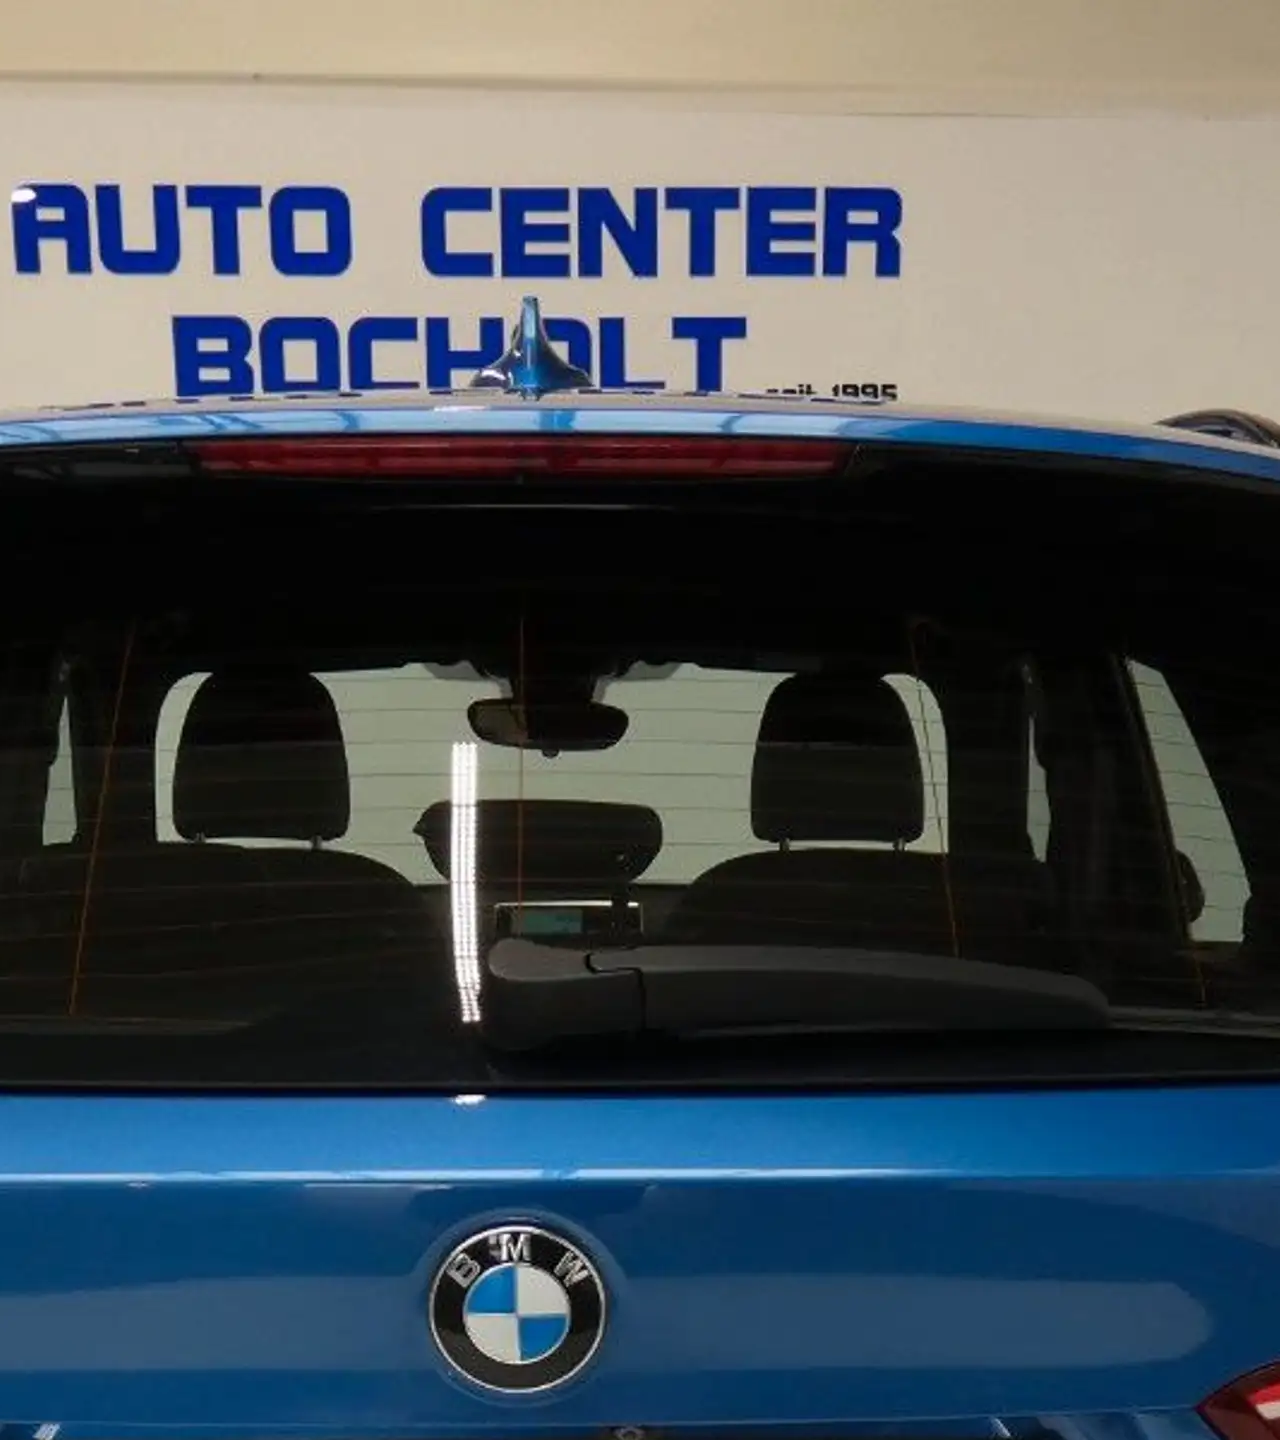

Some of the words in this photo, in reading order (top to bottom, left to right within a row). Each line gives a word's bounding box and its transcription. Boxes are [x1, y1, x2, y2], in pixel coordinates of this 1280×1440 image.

[11, 183, 353, 278] AUTO
[420, 185, 903, 278] CENTER
[446, 1232, 589, 1289] BMW
